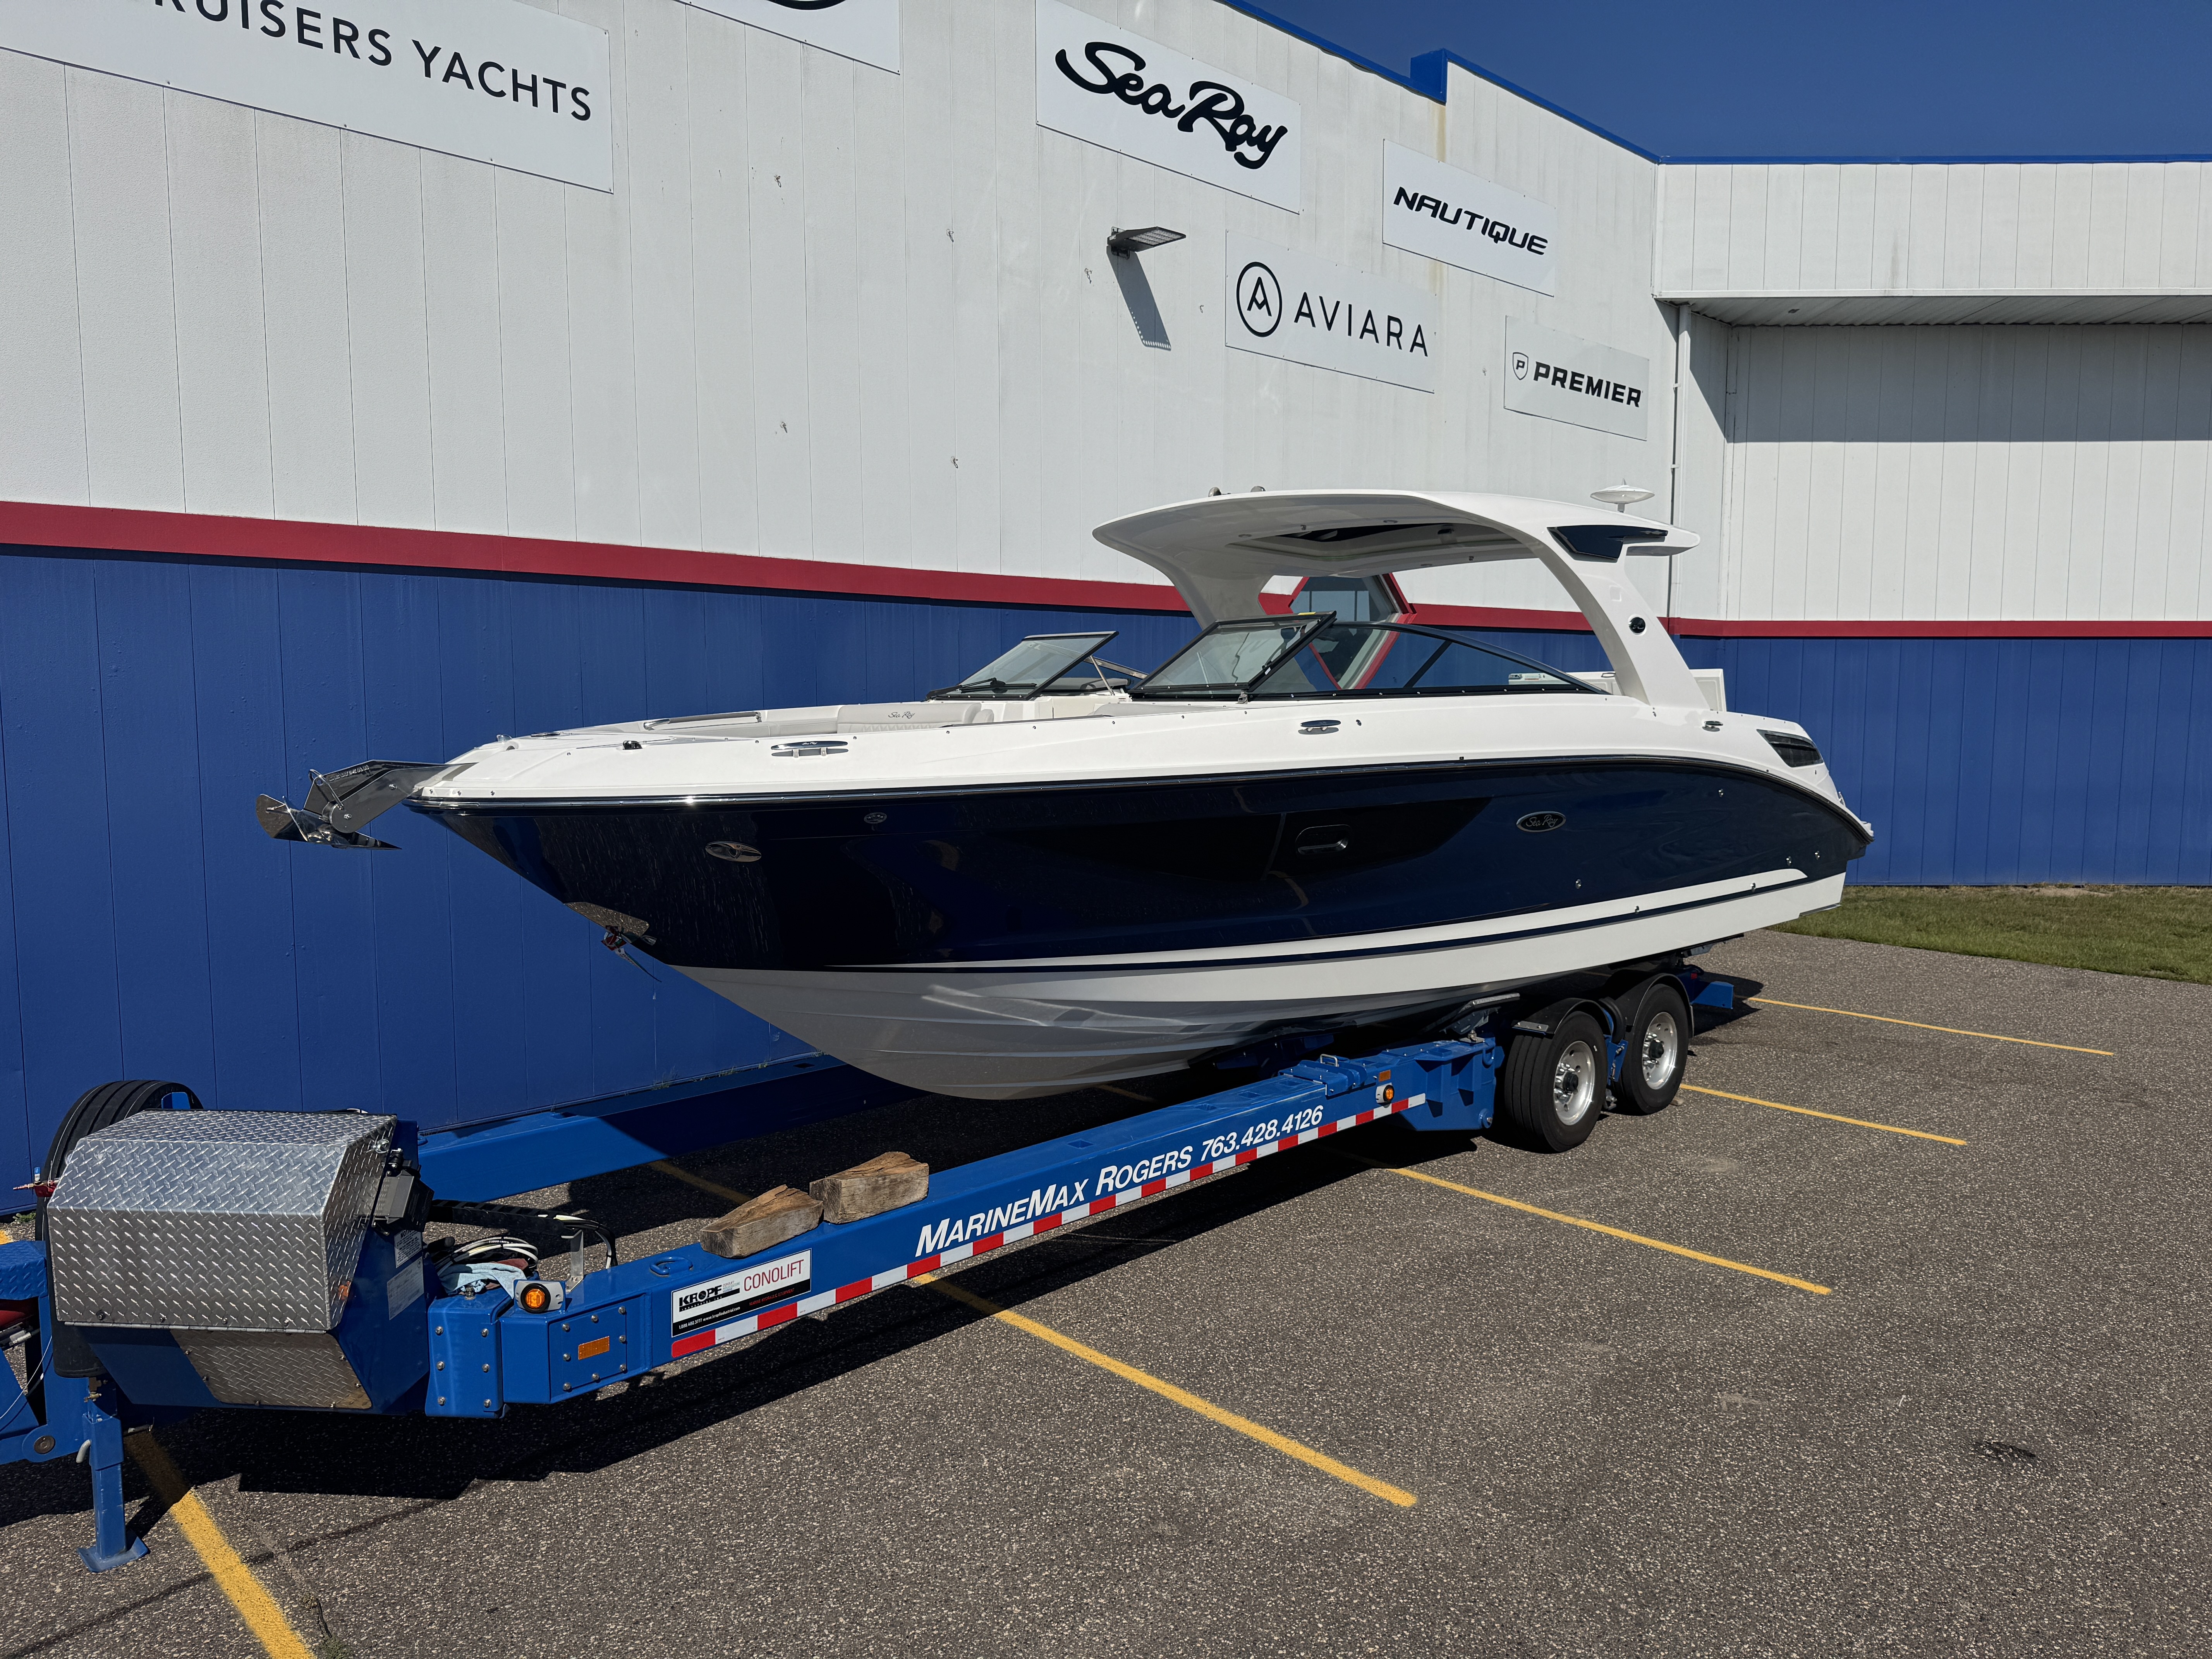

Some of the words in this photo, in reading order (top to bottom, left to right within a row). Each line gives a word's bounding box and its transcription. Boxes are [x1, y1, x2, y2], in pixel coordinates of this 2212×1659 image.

[155, 0, 391, 66] UISERS
[412, 40, 591, 121] YACHTS
[1055, 42, 1185, 118] Sea
[1178, 81, 1288, 169] Ray
[1393, 186, 1548, 255] NAUTIQUE
[1294, 292, 1428, 357] AVIARA
[1533, 361, 1641, 407] PREMIER
[1526, 817, 1541, 827] Sea
[1542, 814, 1558, 828] Ray
[1200, 1105, 1324, 1161] 763.428.4126
[679, 1285, 722, 1307] KROPF
[744, 1259, 804, 1291] CONOLIFT
